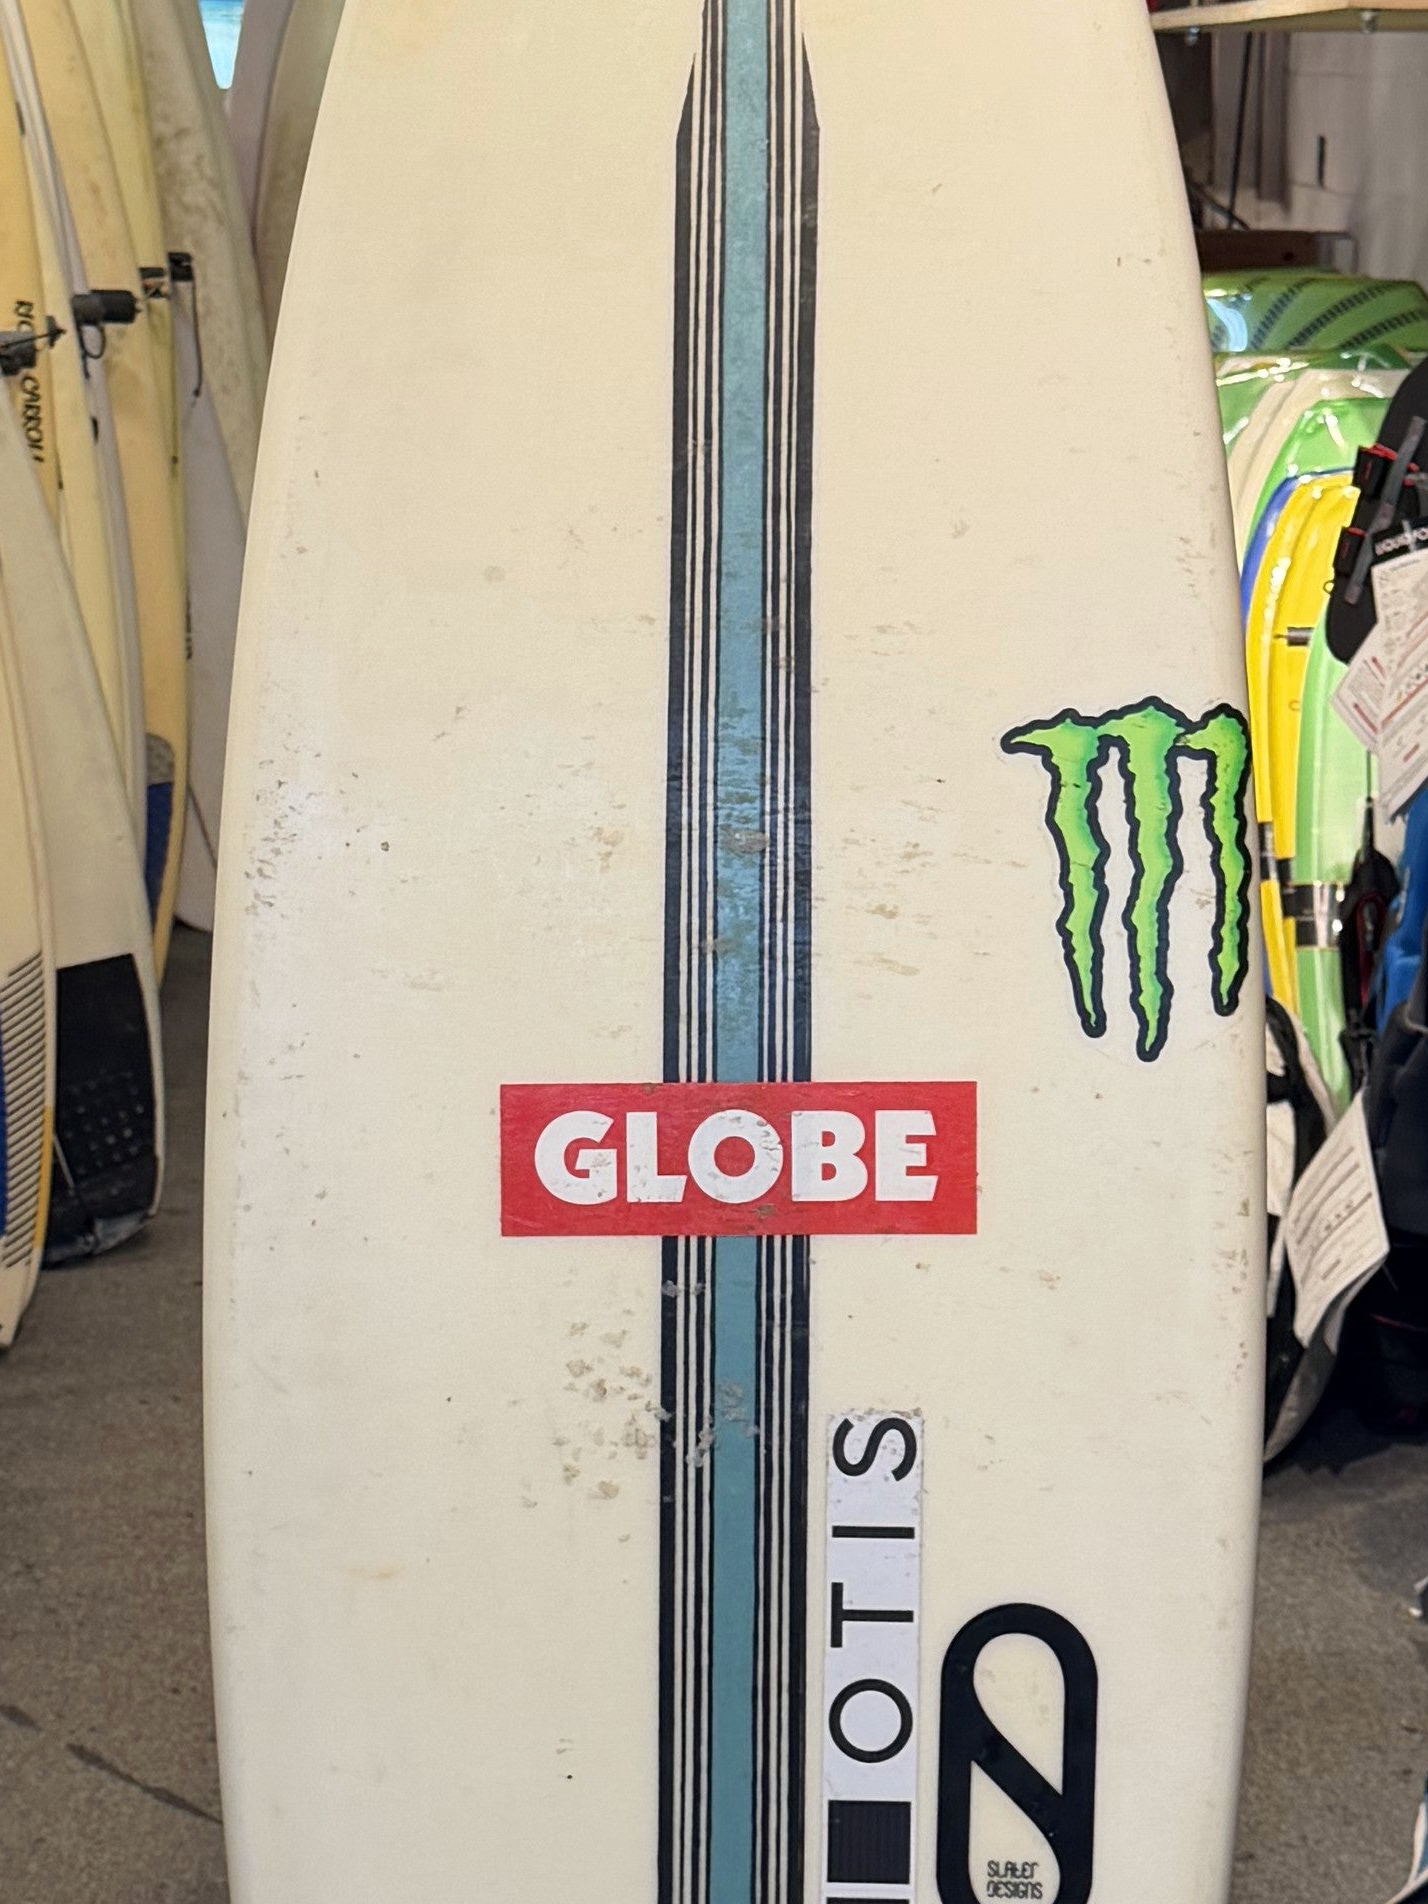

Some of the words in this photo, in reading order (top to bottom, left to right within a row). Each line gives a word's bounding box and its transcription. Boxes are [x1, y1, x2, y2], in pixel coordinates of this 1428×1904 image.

[534, 1109, 939, 1205] GLOBE
[827, 1416, 918, 1764] OTIS
[987, 1860, 1039, 1879] SLATER
[987, 1880, 1043, 1899] DESIGNS
